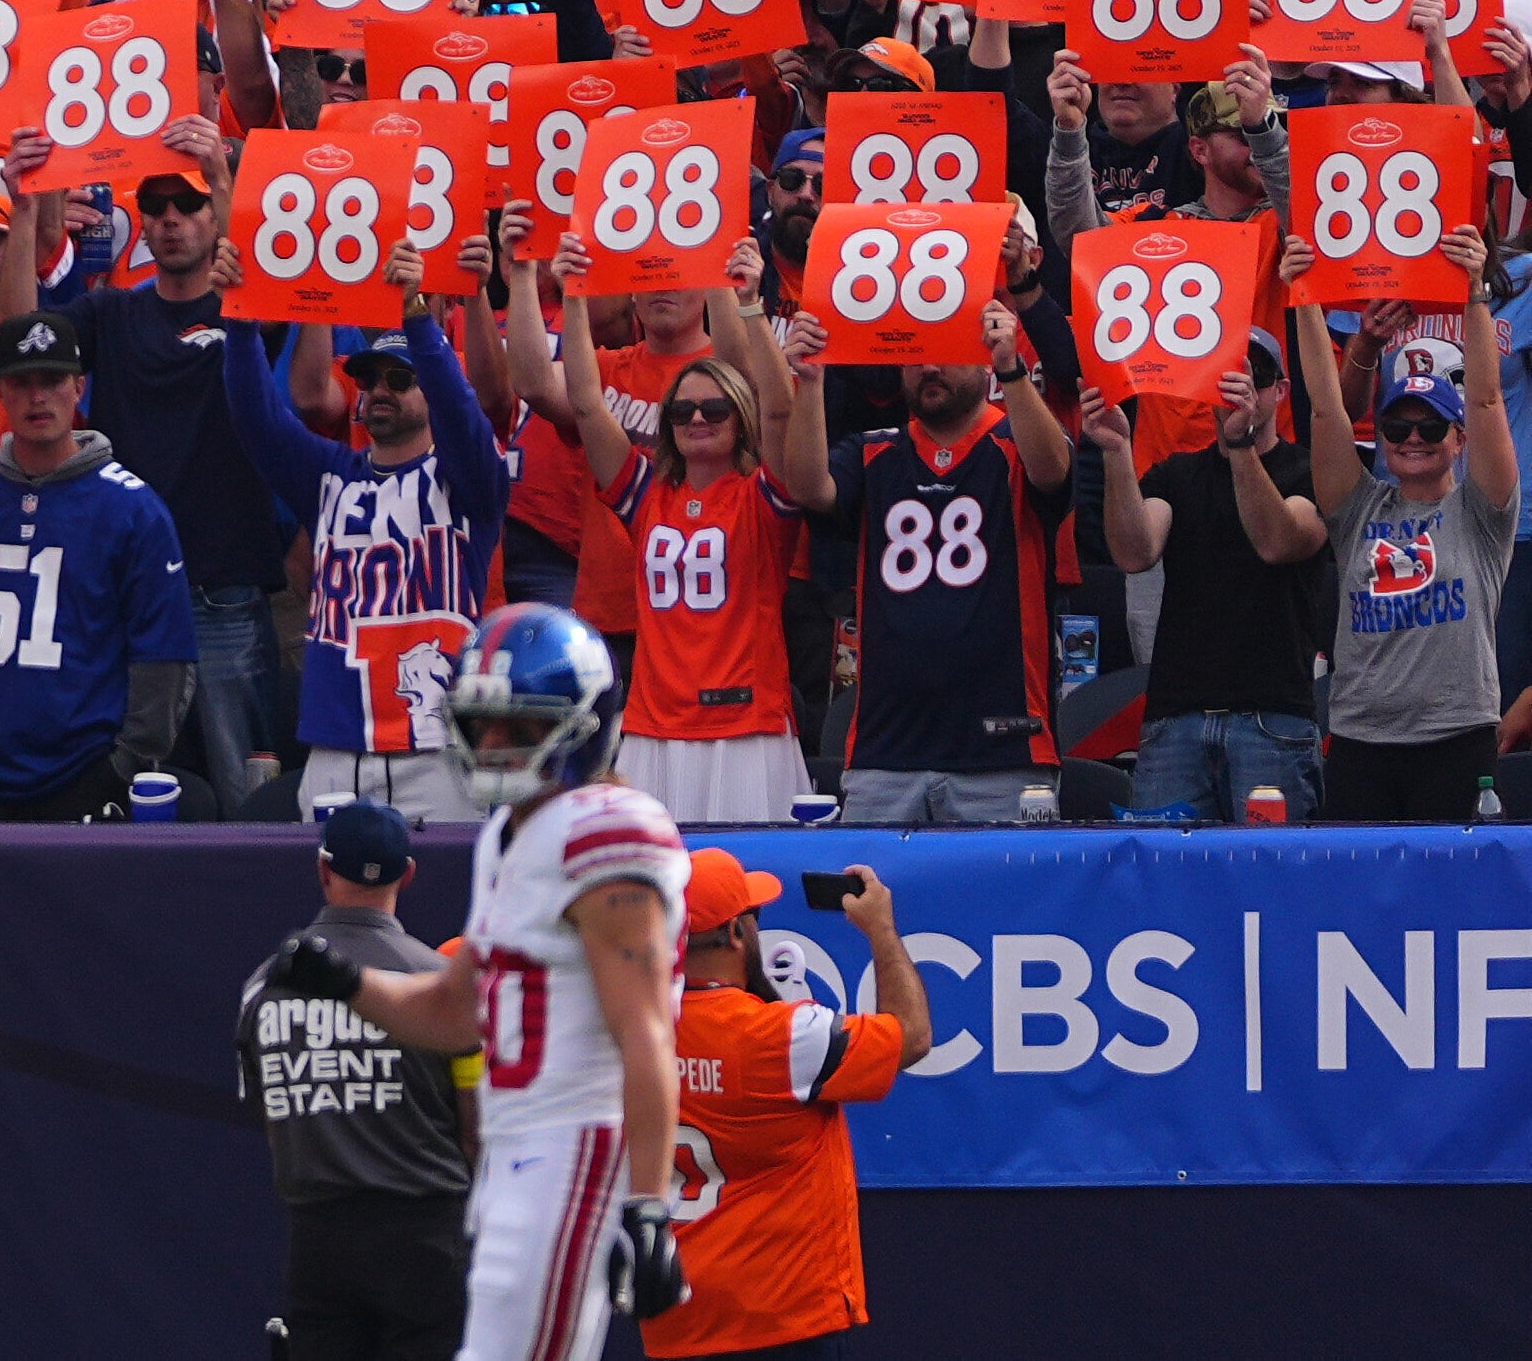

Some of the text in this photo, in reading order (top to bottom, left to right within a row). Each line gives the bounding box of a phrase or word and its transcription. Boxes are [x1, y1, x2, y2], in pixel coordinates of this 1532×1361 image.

[254, 173, 379, 283] 88
[1314, 151, 1442, 258] 88
[831, 228, 968, 322] 88
[644, 525, 728, 611] 88
[880, 495, 989, 593] 88
[1349, 580, 1466, 633] BRONCOS
[855, 930, 1199, 1076] CBS
[260, 1050, 402, 1084] EVENT
[263, 1081, 403, 1118] STAFF
